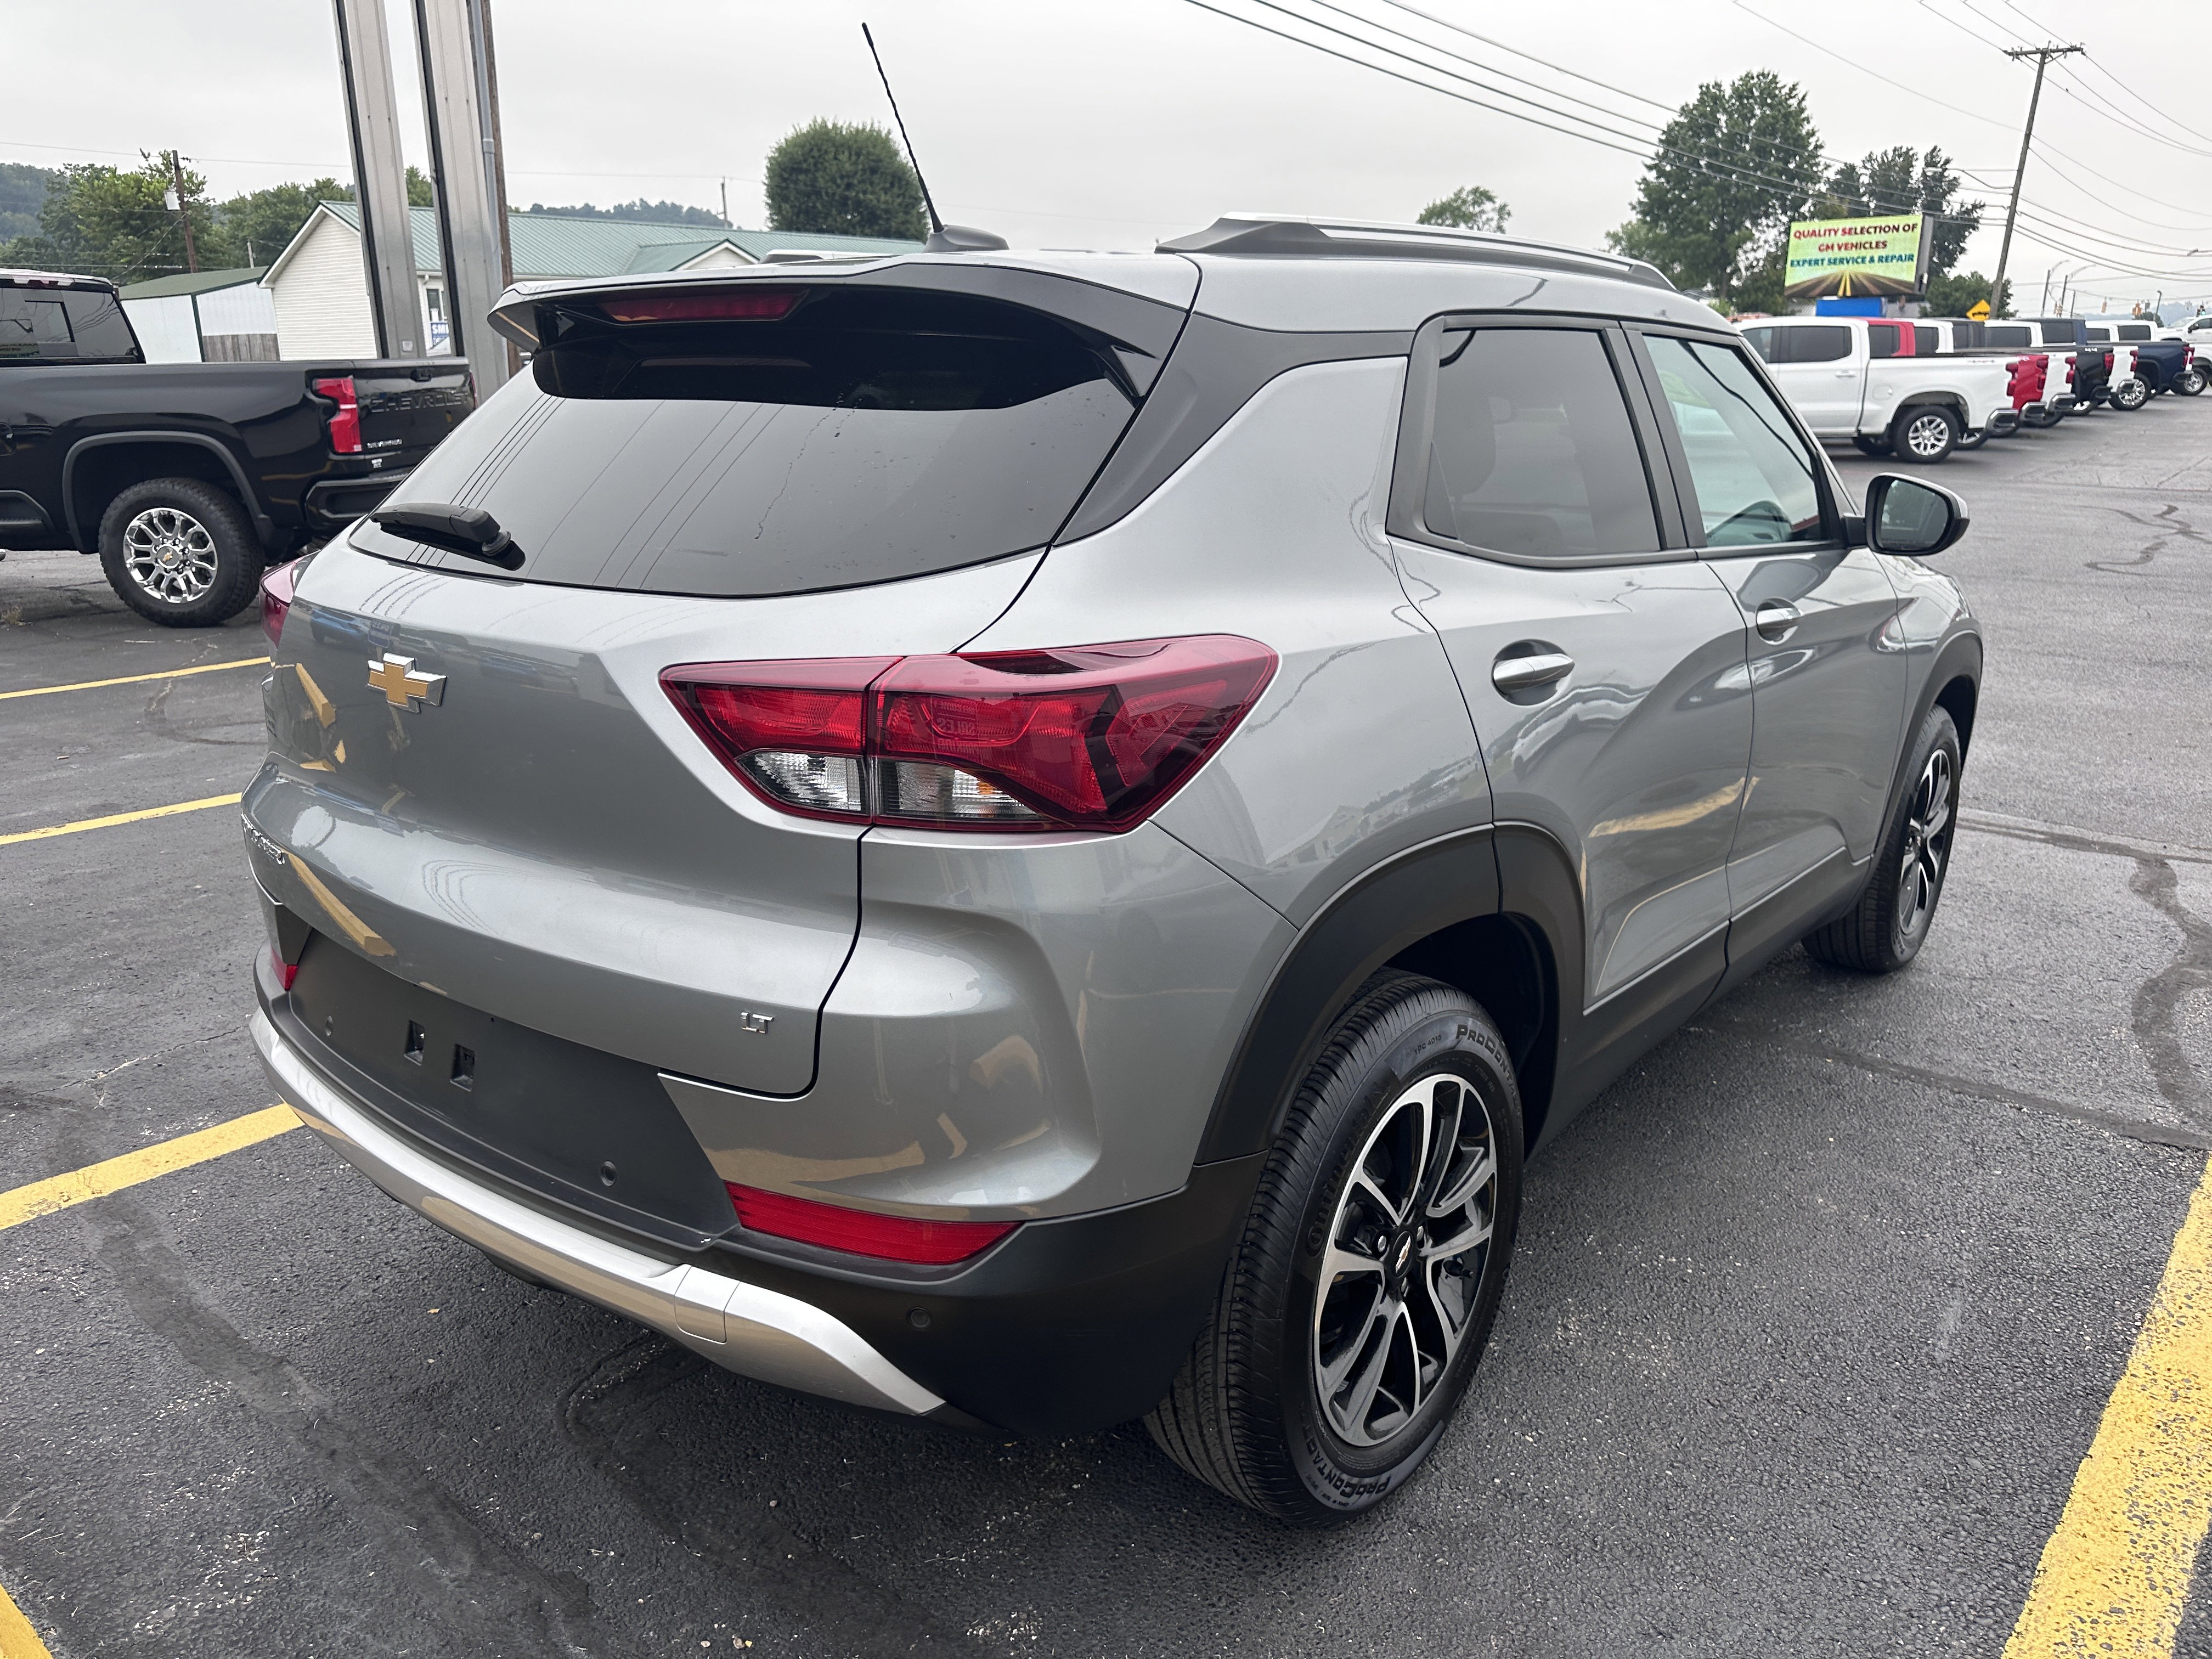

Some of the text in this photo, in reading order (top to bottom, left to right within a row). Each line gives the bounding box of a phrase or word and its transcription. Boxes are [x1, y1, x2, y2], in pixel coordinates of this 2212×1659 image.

[1793, 223, 1918, 240] QUALITY SELECTION OF
[1818, 240, 1888, 252] GM VEHICLES
[1790, 253, 1915, 268] EXPERT SERVICE & REPAIR
[371, 392, 469, 412] CHEVROLET
[741, 1012, 775, 1034] LT
